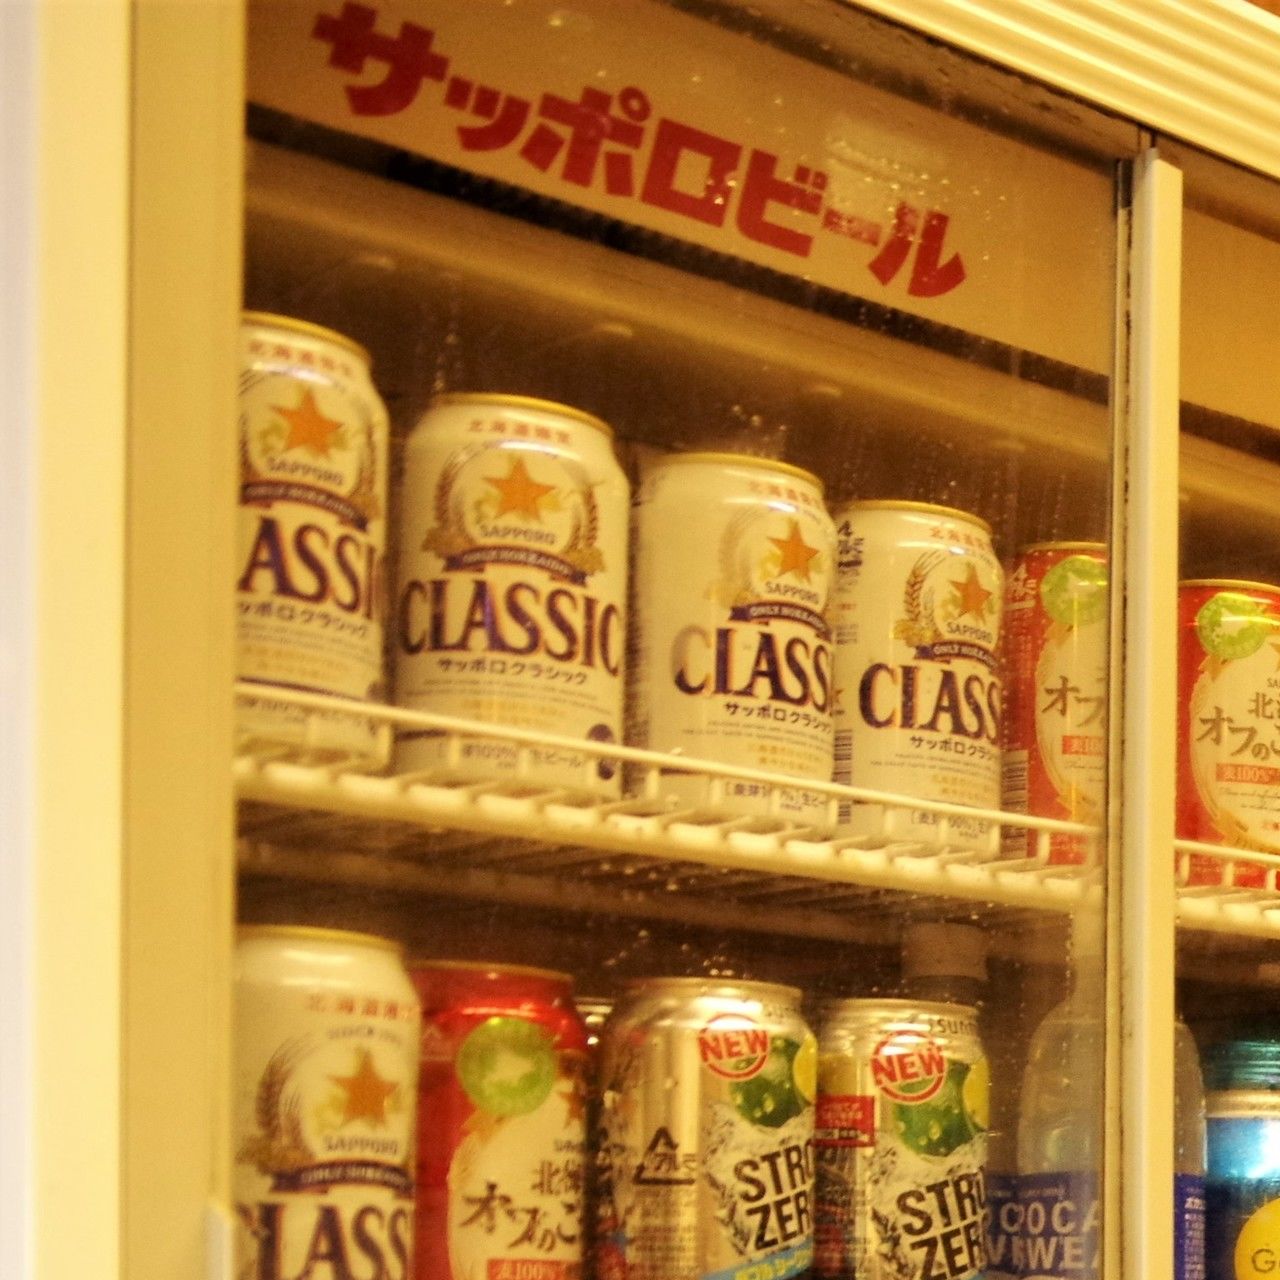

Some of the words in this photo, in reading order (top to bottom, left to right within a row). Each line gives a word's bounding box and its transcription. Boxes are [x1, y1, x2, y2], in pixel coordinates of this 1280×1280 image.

[312, 1, 966, 299] サッポロビール
[479, 522, 558, 547] SAPPORO
[765, 581, 820, 606] SAPPORO
[239, 600, 370, 638] ッポロクラシック
[401, 579, 620, 678] CLASSIC
[437, 656, 589, 686] サッポロクラシック
[701, 1028, 768, 1063] NEW
[872, 1046, 946, 1087] NEW
